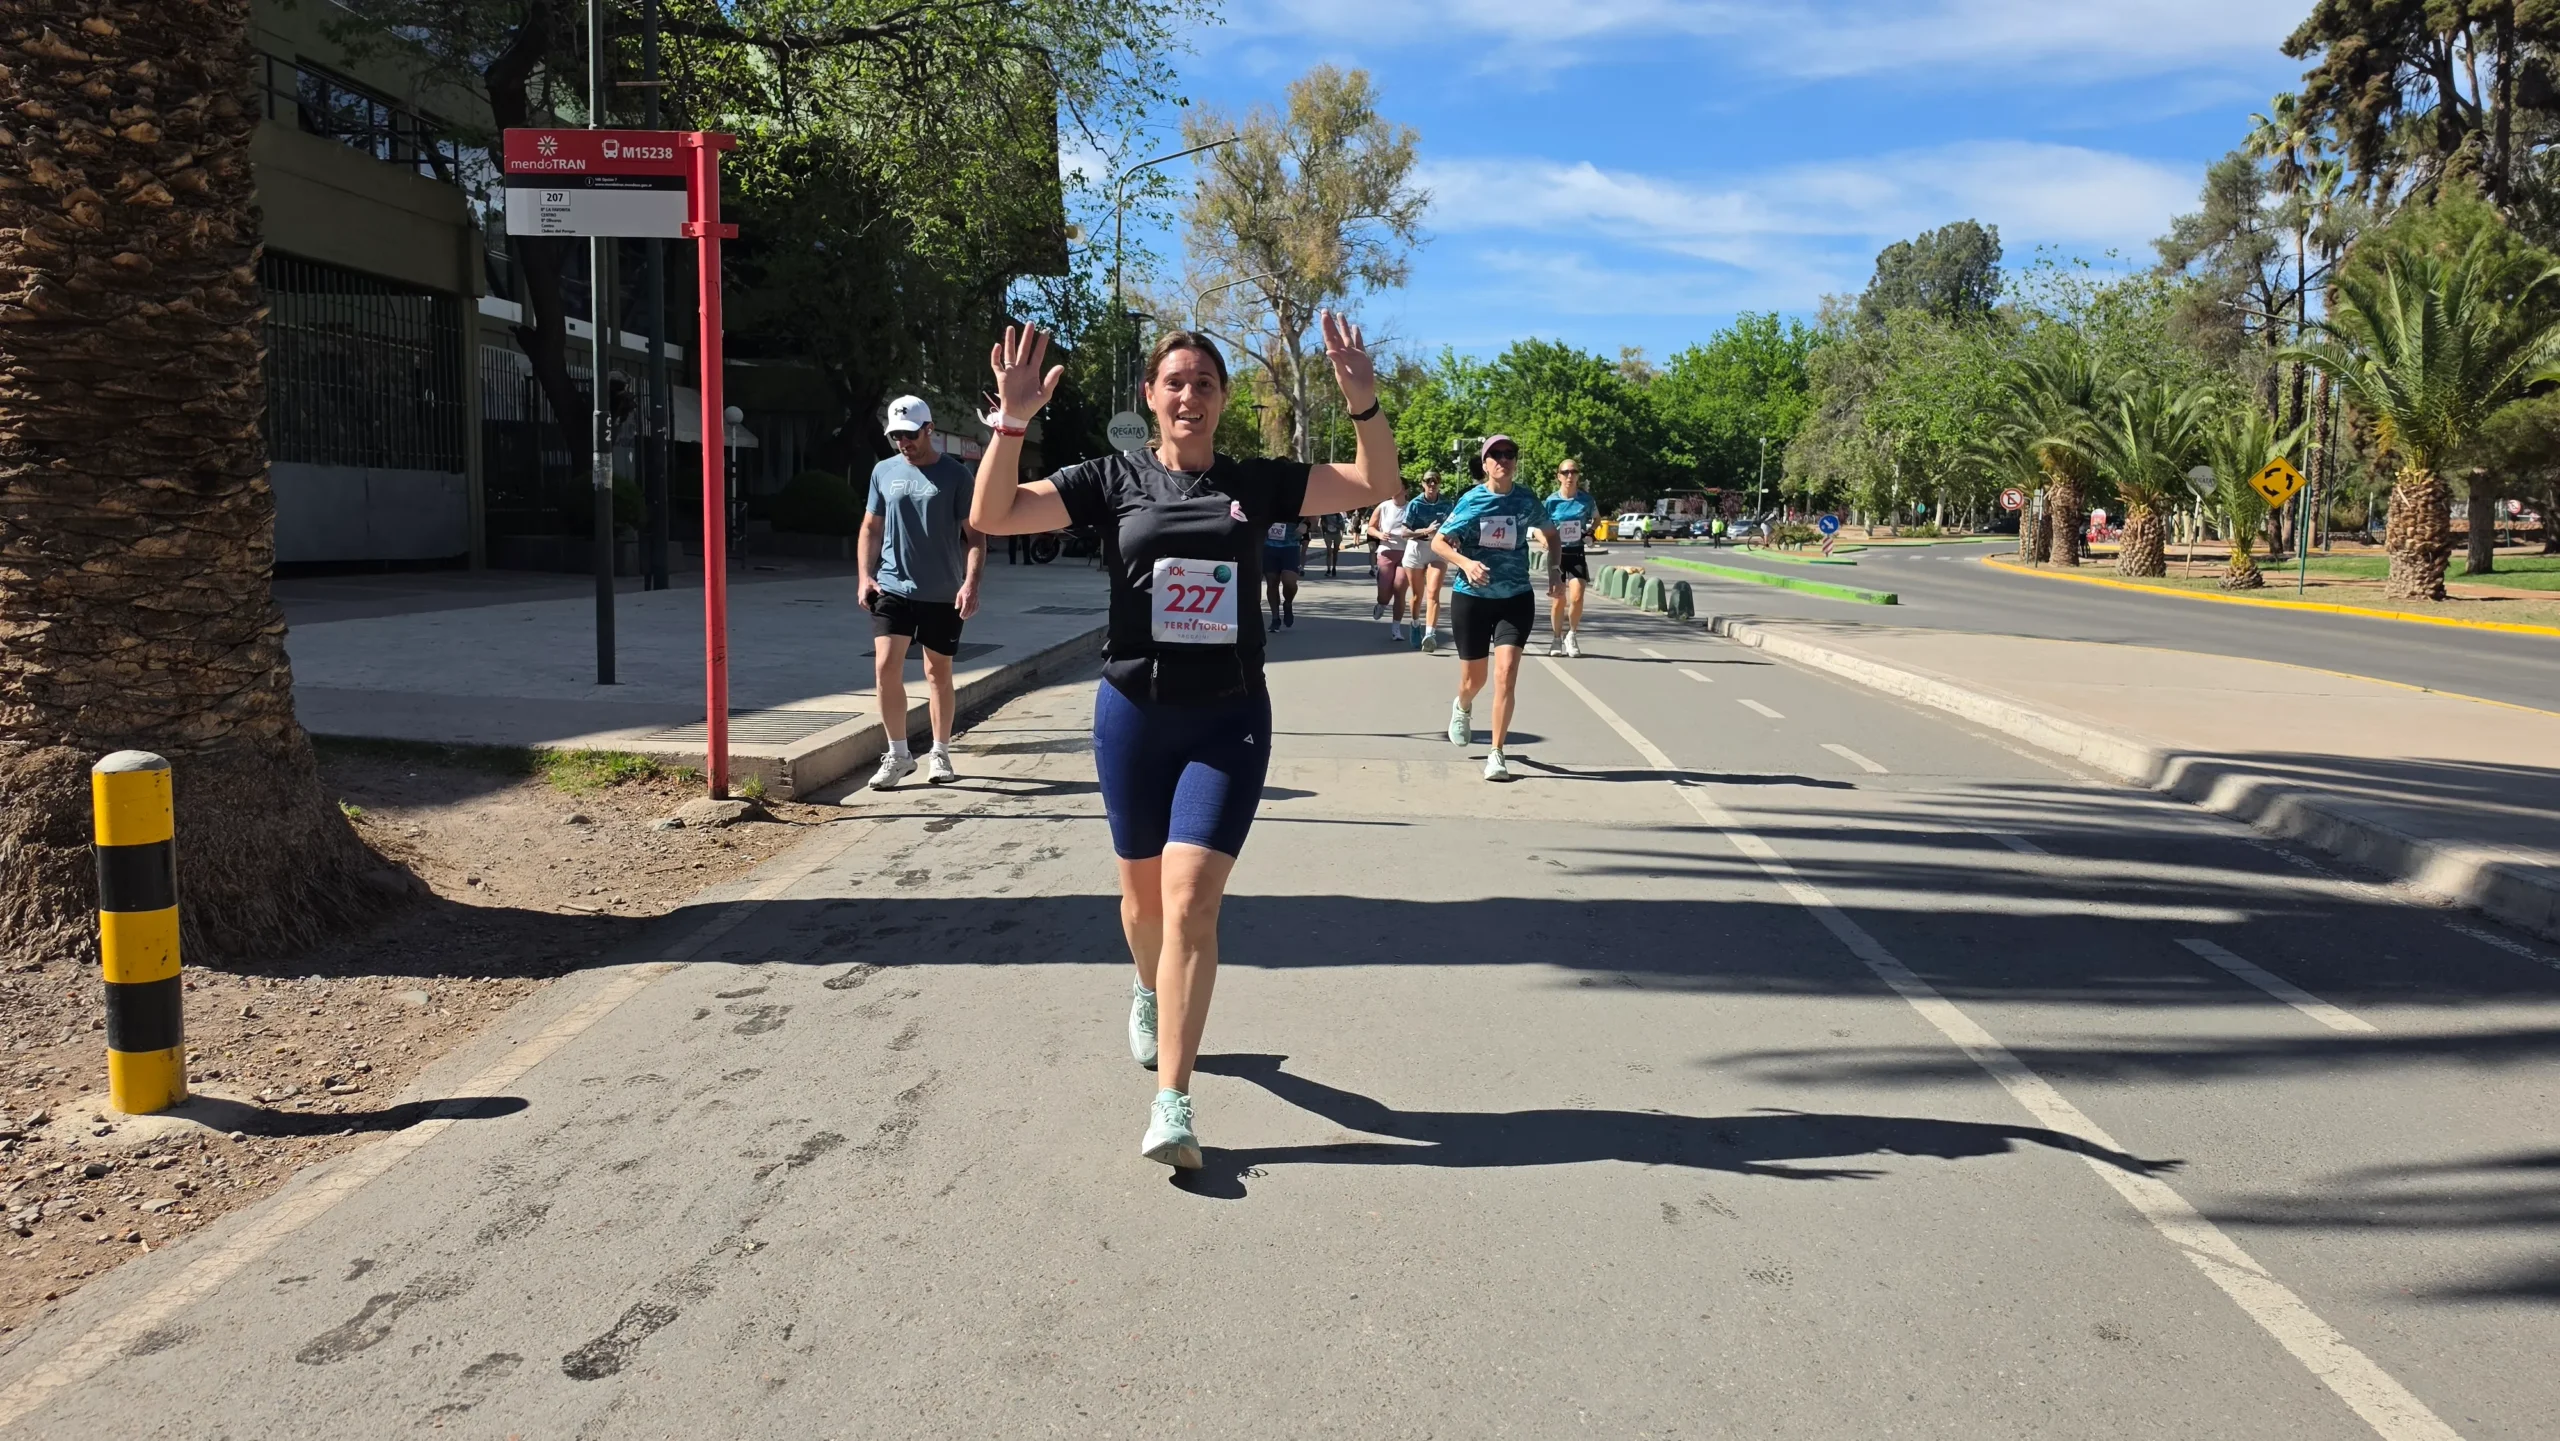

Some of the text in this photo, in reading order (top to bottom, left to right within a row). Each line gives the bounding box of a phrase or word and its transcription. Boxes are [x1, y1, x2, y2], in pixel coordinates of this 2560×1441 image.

[622, 146, 673, 159] M15238
[511, 159, 586, 170] mendoTRAN
[546, 192, 564, 202] 207
[1109, 426, 1146, 439] REGATAS
[890, 479, 938, 496] FILA
[1491, 526, 1506, 539] 41
[1168, 565, 1186, 577] 10k
[1163, 583, 1226, 614] 227
